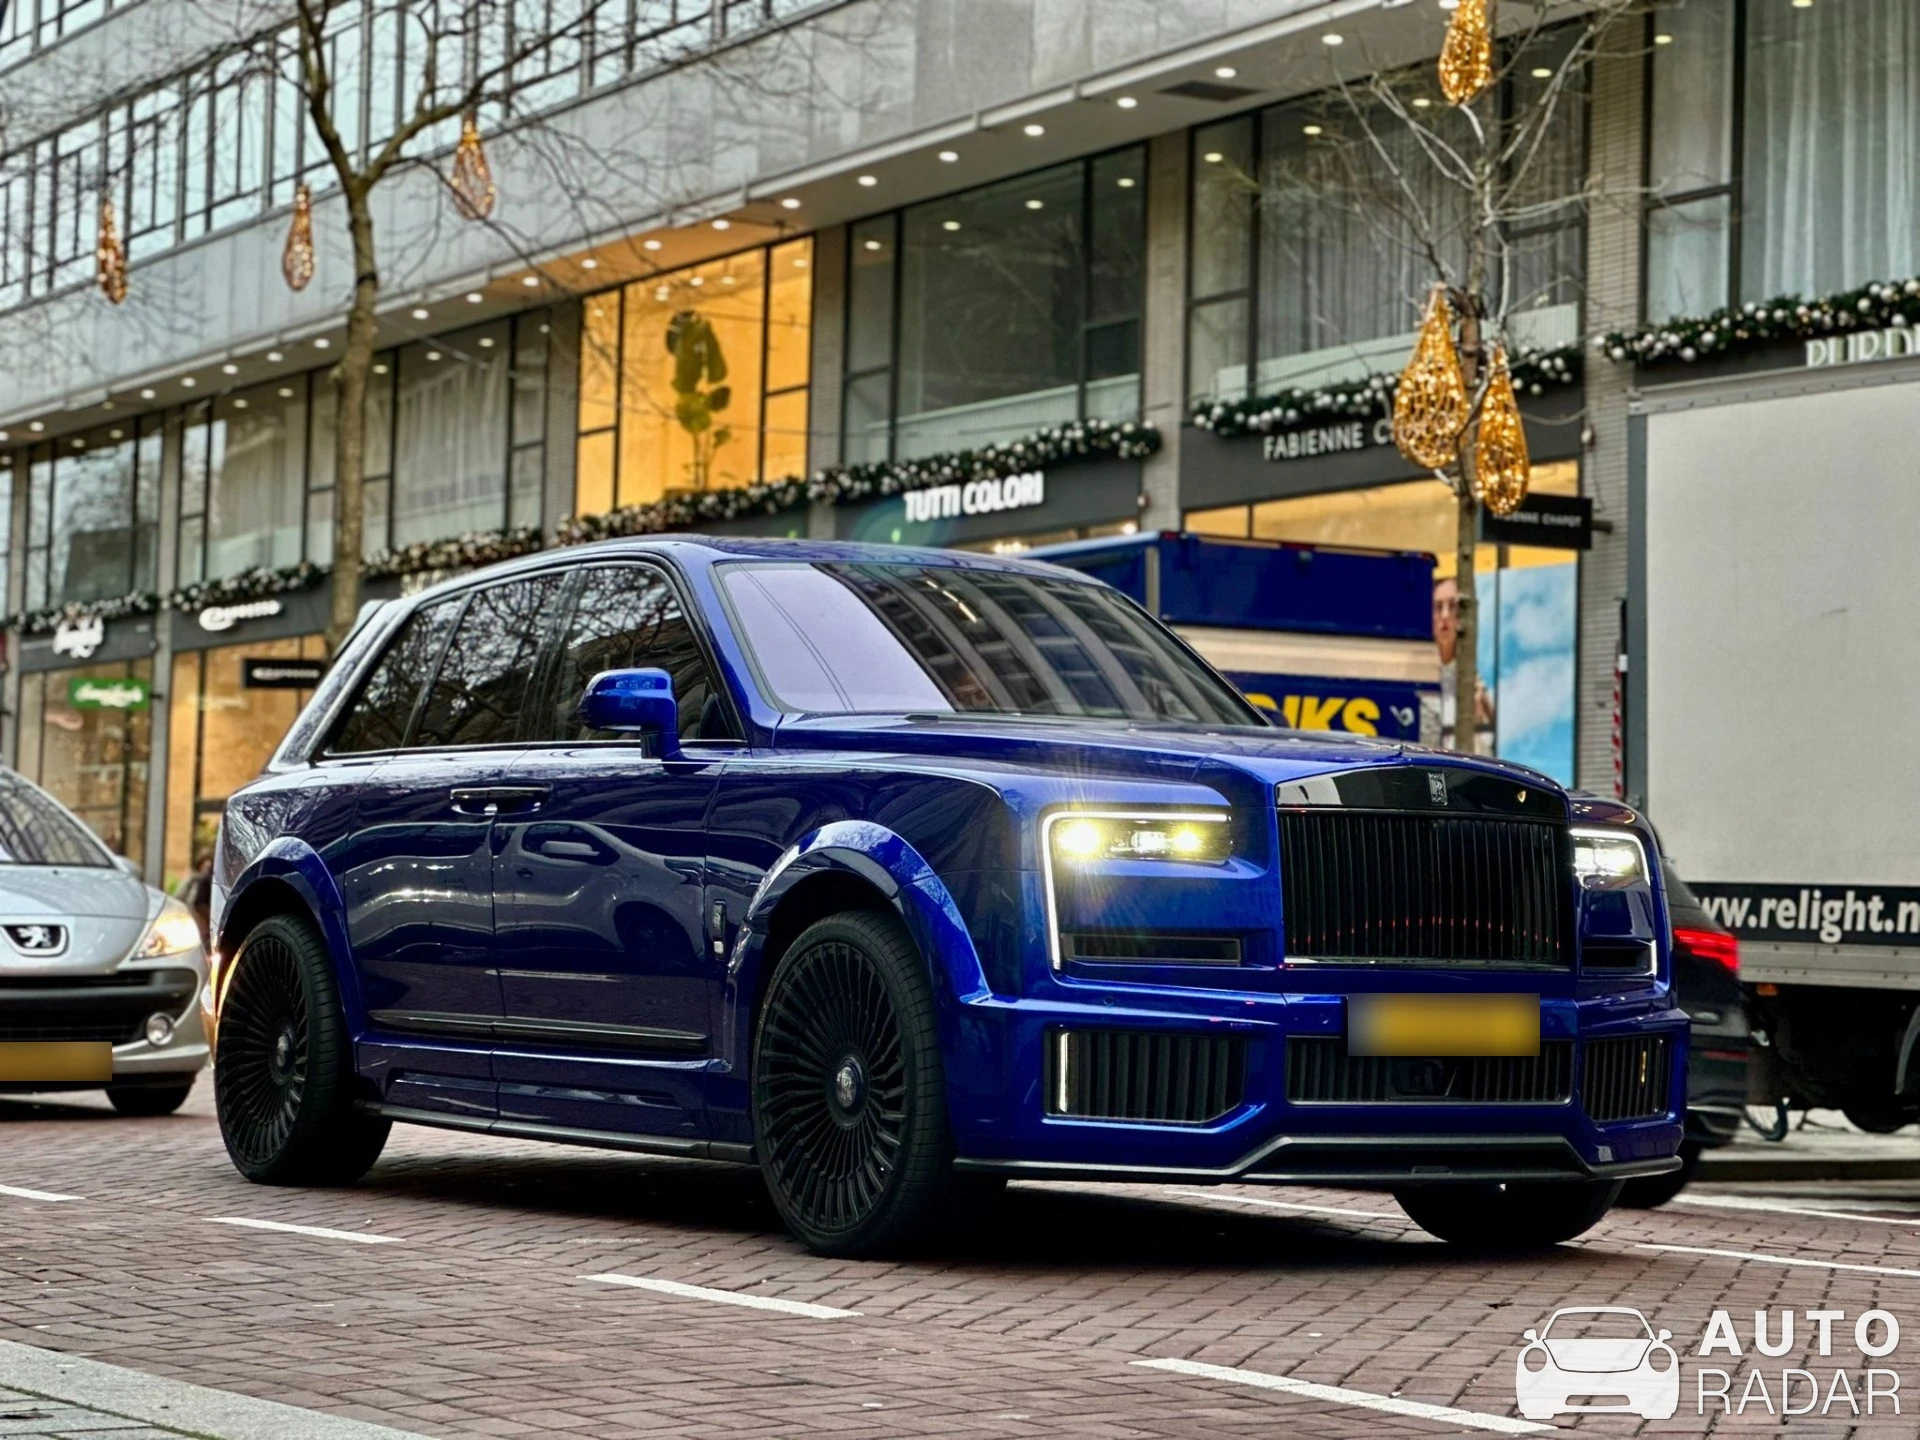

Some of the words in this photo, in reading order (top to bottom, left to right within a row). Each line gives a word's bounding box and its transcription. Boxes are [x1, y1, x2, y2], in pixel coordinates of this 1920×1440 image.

[1263, 421, 1364, 461] FABIENNE
[903, 483, 961, 523] TUTTI
[963, 470, 1044, 515] COLORI
